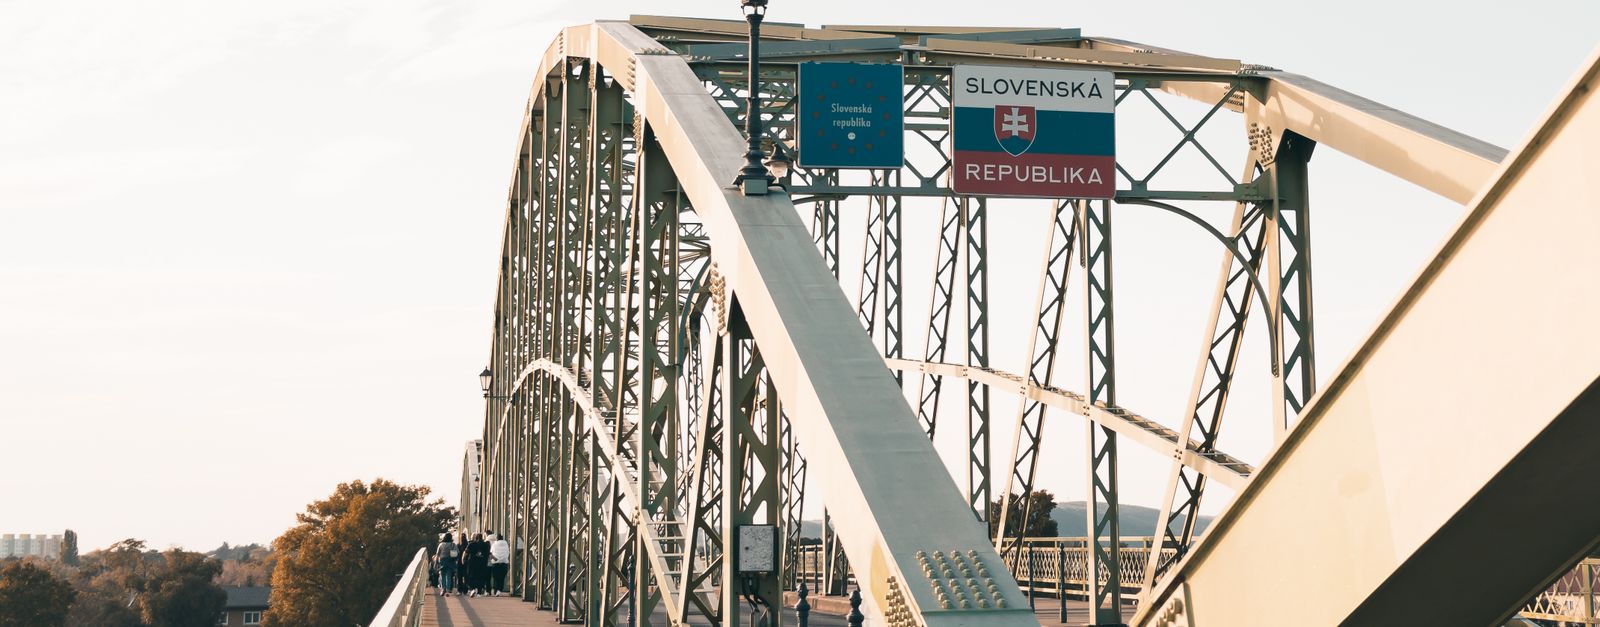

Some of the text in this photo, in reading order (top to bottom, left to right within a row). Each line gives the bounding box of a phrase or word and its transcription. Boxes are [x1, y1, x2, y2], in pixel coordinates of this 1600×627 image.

[966, 77, 1103, 99] SLOVENSKÁ
[831, 103, 873, 113] Slovenská
[832, 117, 871, 129] republika
[966, 163, 1103, 184] REPUBLIKA
